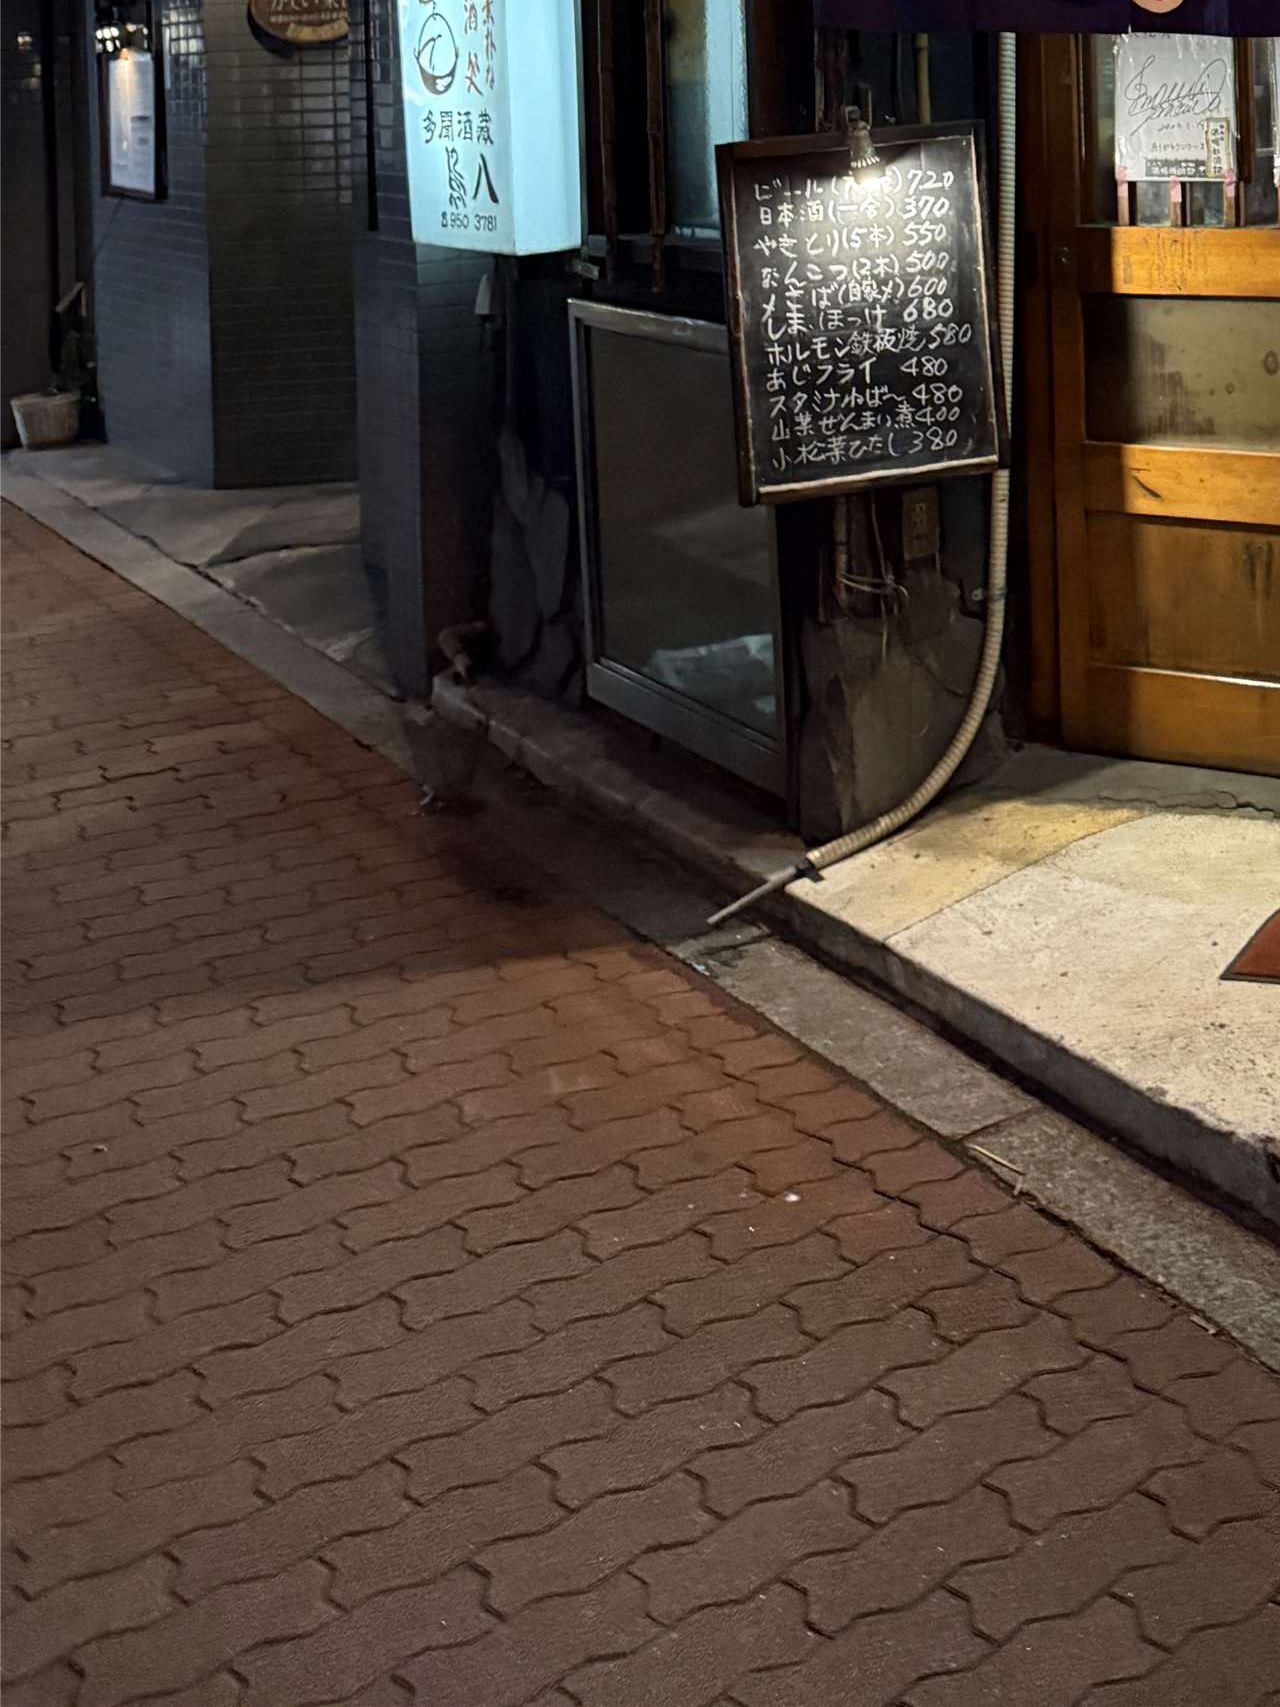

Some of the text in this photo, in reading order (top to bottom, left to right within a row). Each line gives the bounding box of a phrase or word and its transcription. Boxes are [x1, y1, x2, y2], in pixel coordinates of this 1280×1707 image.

[907, 170, 954, 196] 720
[902, 194, 951, 220] 370
[902, 220, 947, 247] 550
[907, 275, 949, 298] 600
[903, 297, 954, 322] 680
[928, 323, 973, 351] 580
[900, 355, 949, 377] 480
[911, 383, 964, 406] 480
[914, 406, 961, 426] 400
[907, 425, 959, 454] 380
